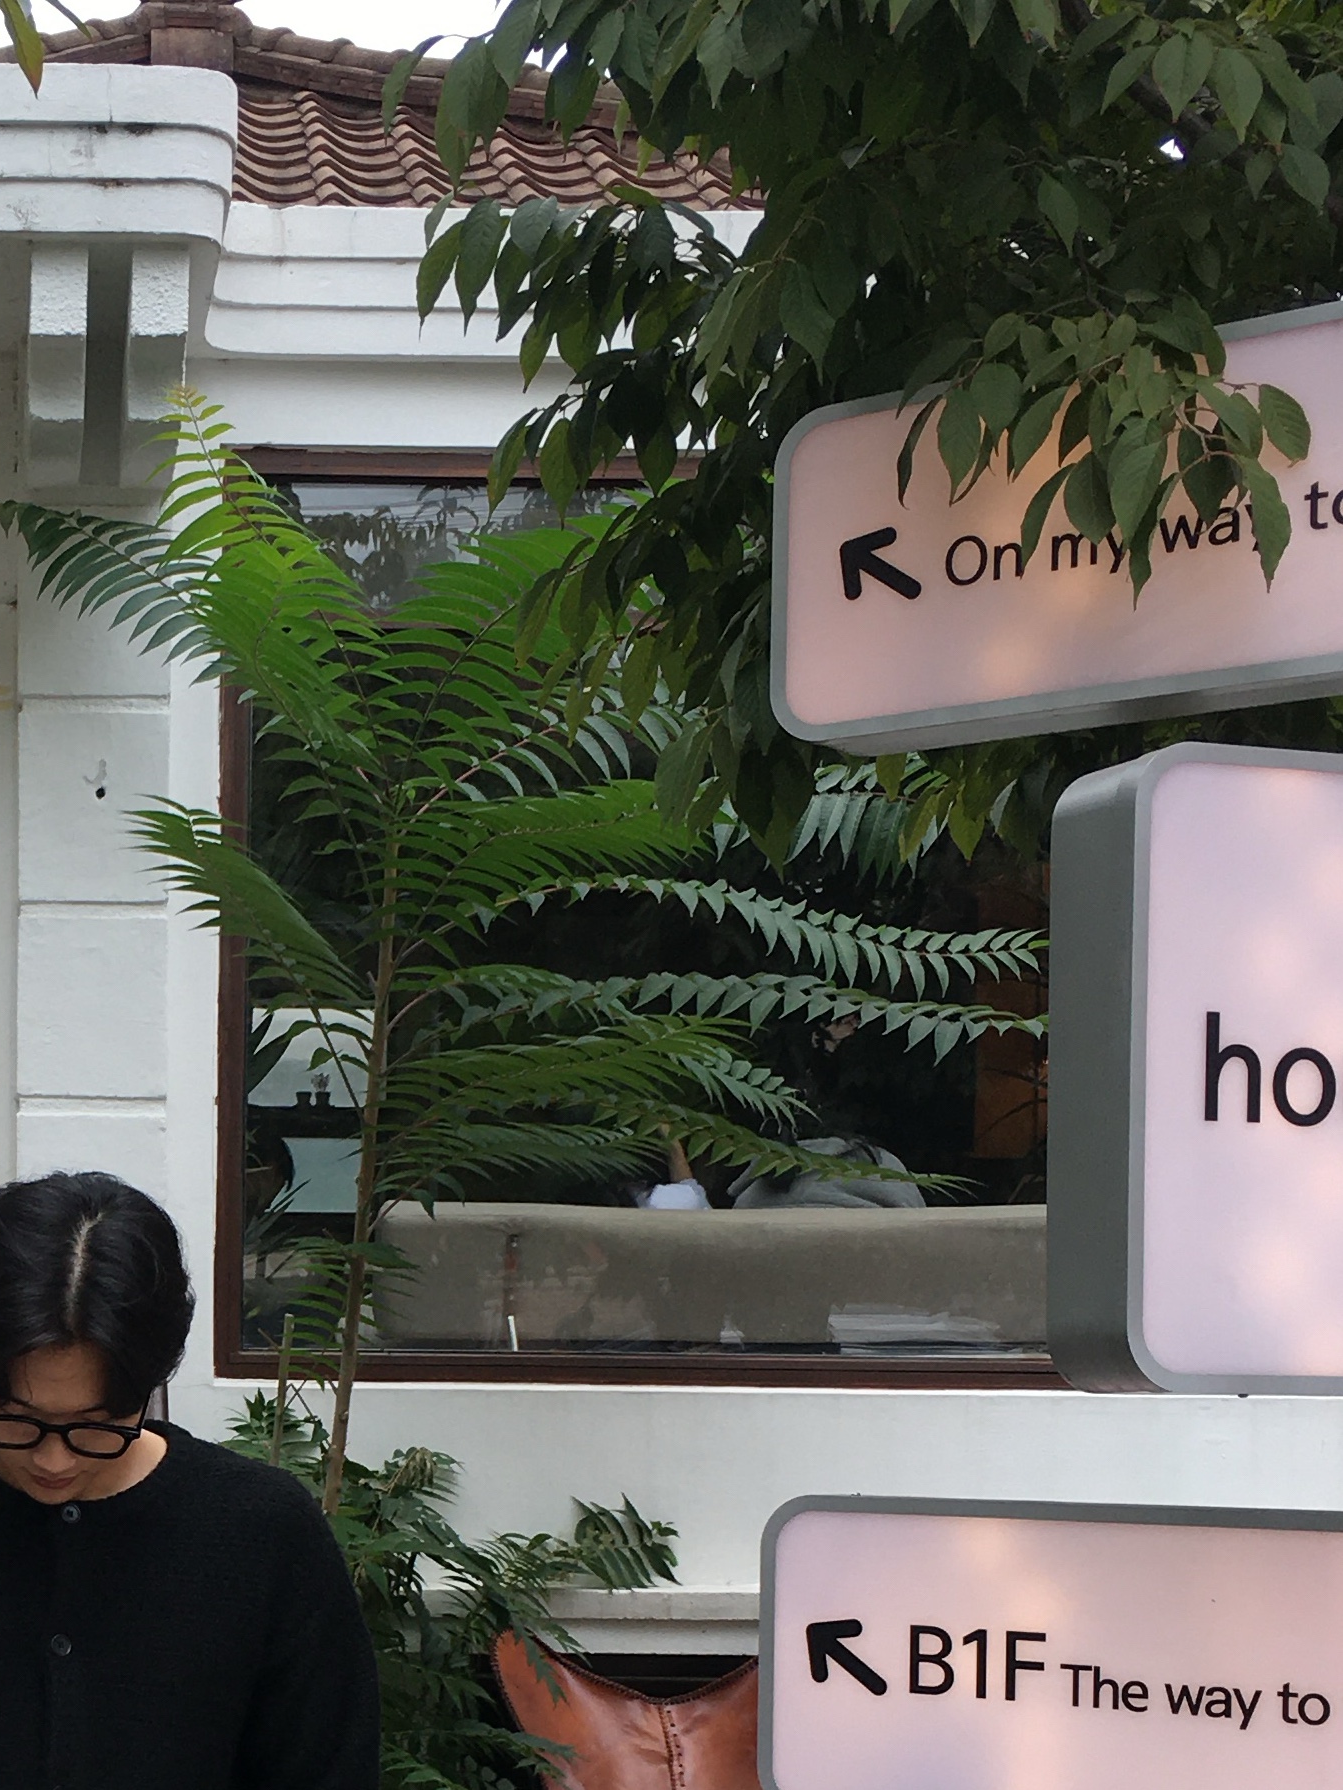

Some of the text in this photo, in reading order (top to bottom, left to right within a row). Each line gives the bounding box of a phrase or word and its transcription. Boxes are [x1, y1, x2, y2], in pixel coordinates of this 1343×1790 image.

[946, 534, 1022, 587] On
[1204, 1011, 1337, 1128] ho
[908, 1624, 1331, 1730] B1F The way to
